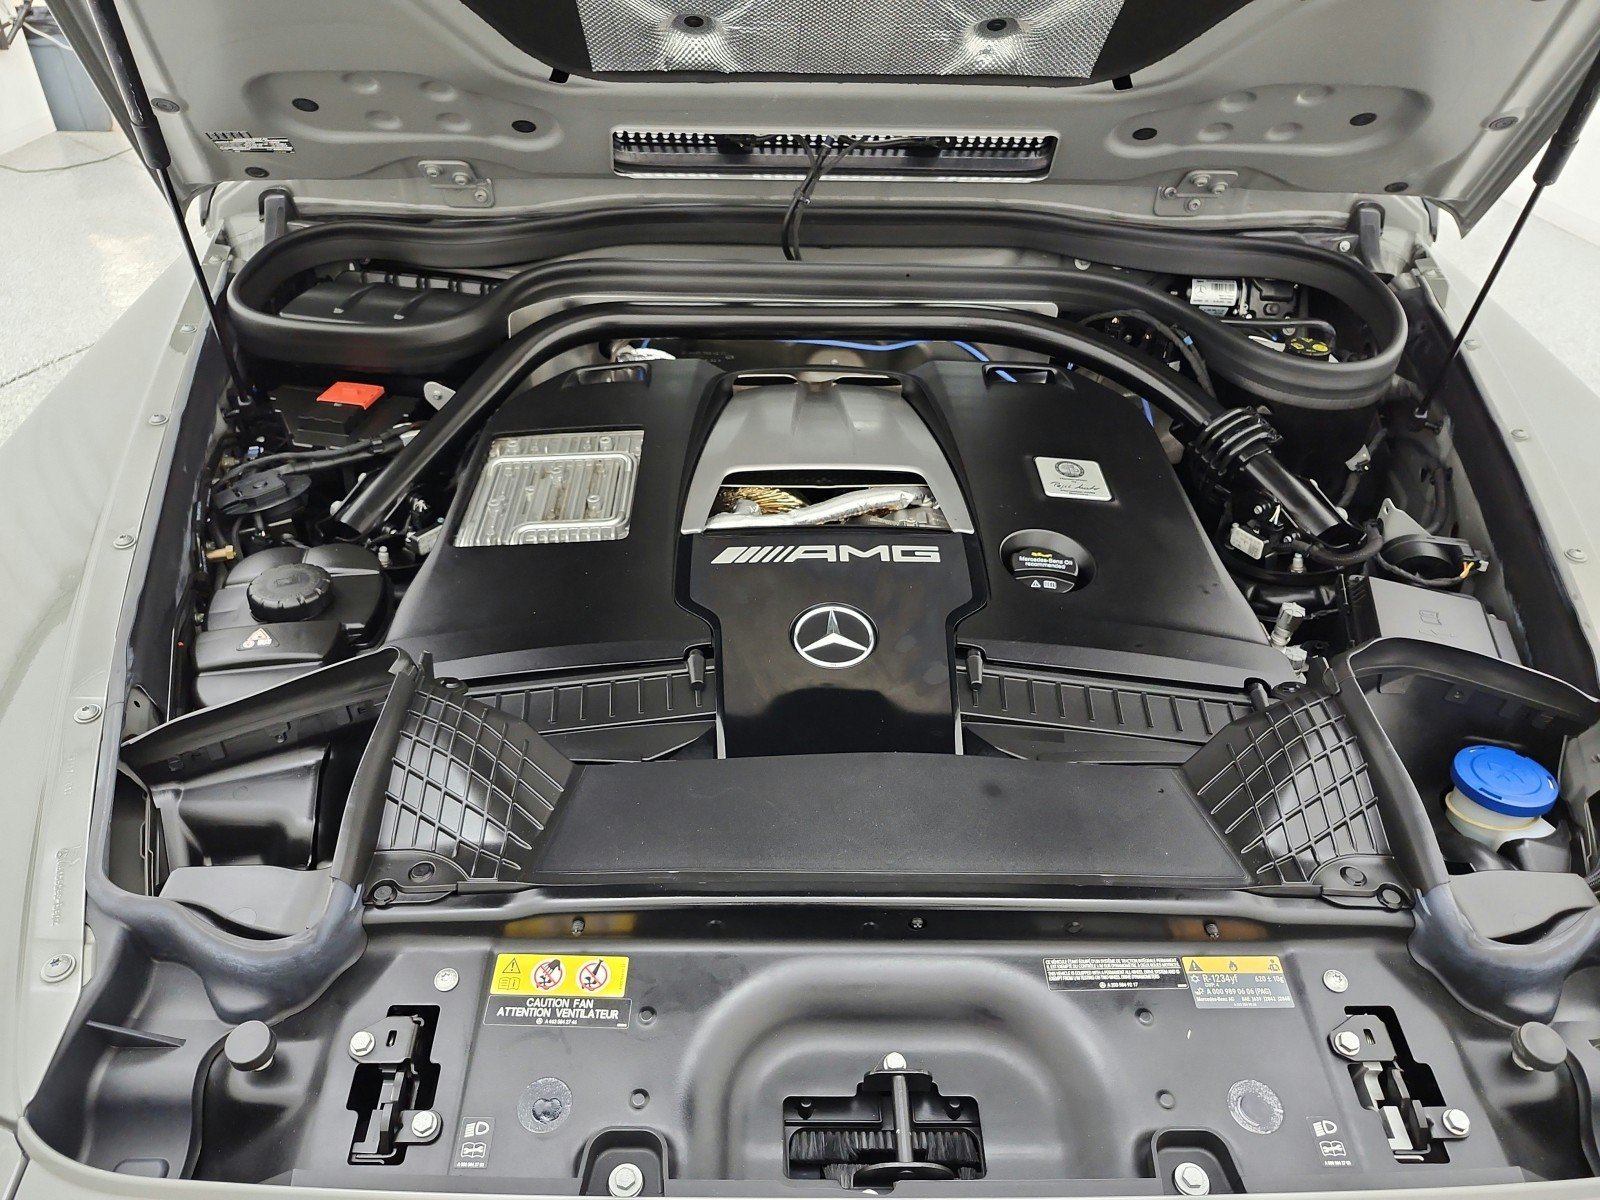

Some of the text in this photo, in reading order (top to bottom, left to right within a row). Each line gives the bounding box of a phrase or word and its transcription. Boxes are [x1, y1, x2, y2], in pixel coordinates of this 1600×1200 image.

[784, 545, 941, 563] AMG
[1019, 556, 1063, 564] Mercedes-Benz
[1202, 974, 1238, 984] R-1234yf
[526, 998, 594, 1008] CAUTION FAN
[496, 1006, 619, 1019] ATTENTION VENTILATEUR
